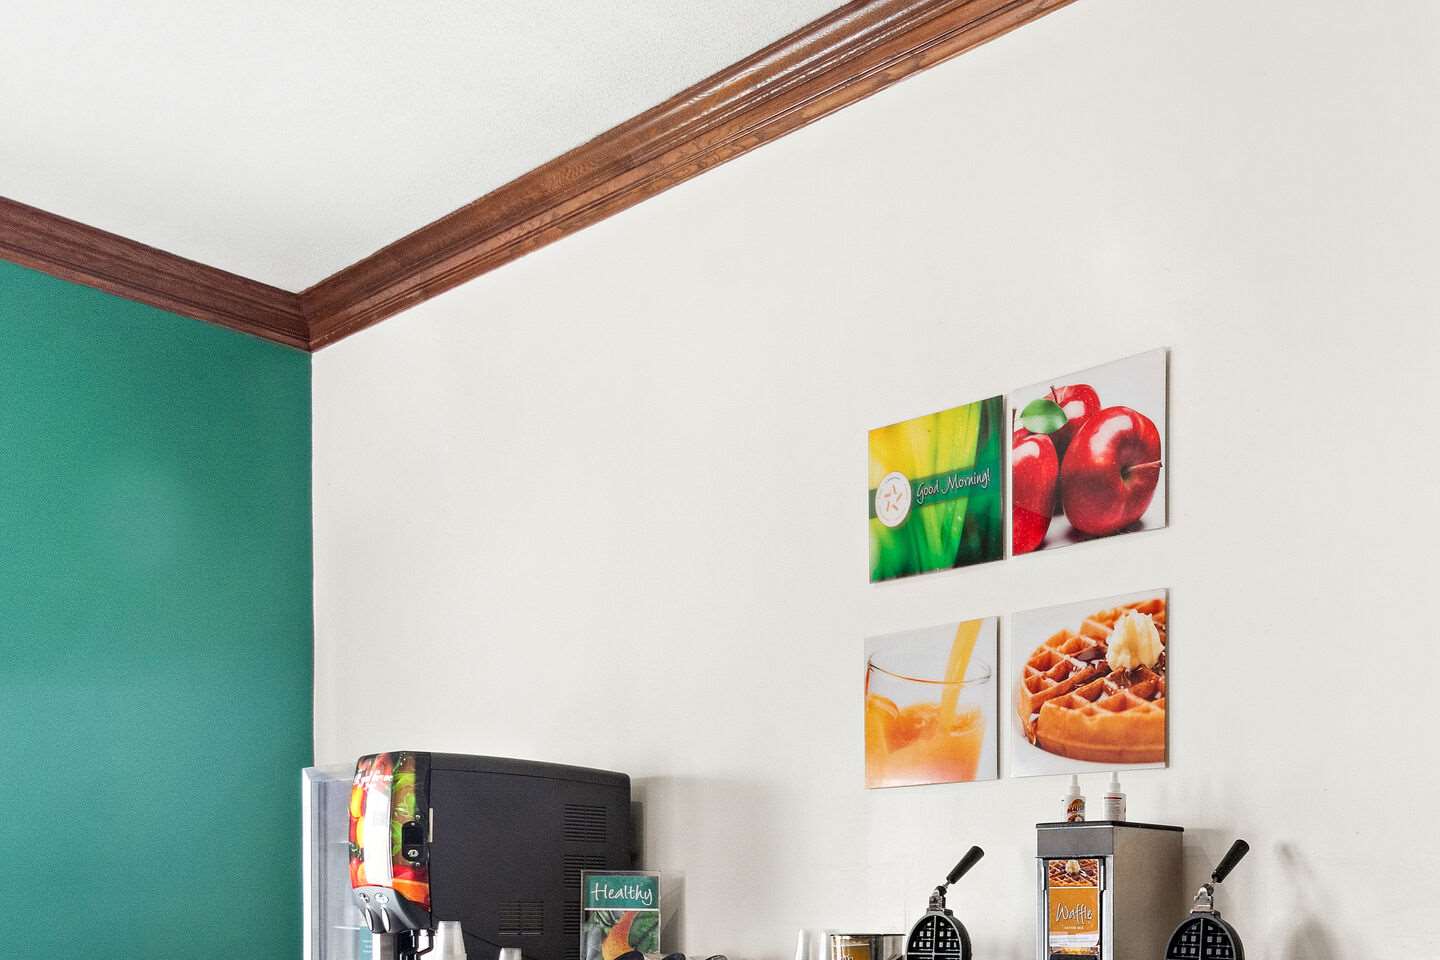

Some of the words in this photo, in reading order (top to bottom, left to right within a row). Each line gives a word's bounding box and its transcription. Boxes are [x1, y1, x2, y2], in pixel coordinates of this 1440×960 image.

[916, 479, 939, 504] Good
[941, 467, 991, 494] Morning!
[590, 882, 653, 906] Healthy
[1055, 903, 1093, 924] Waffle
